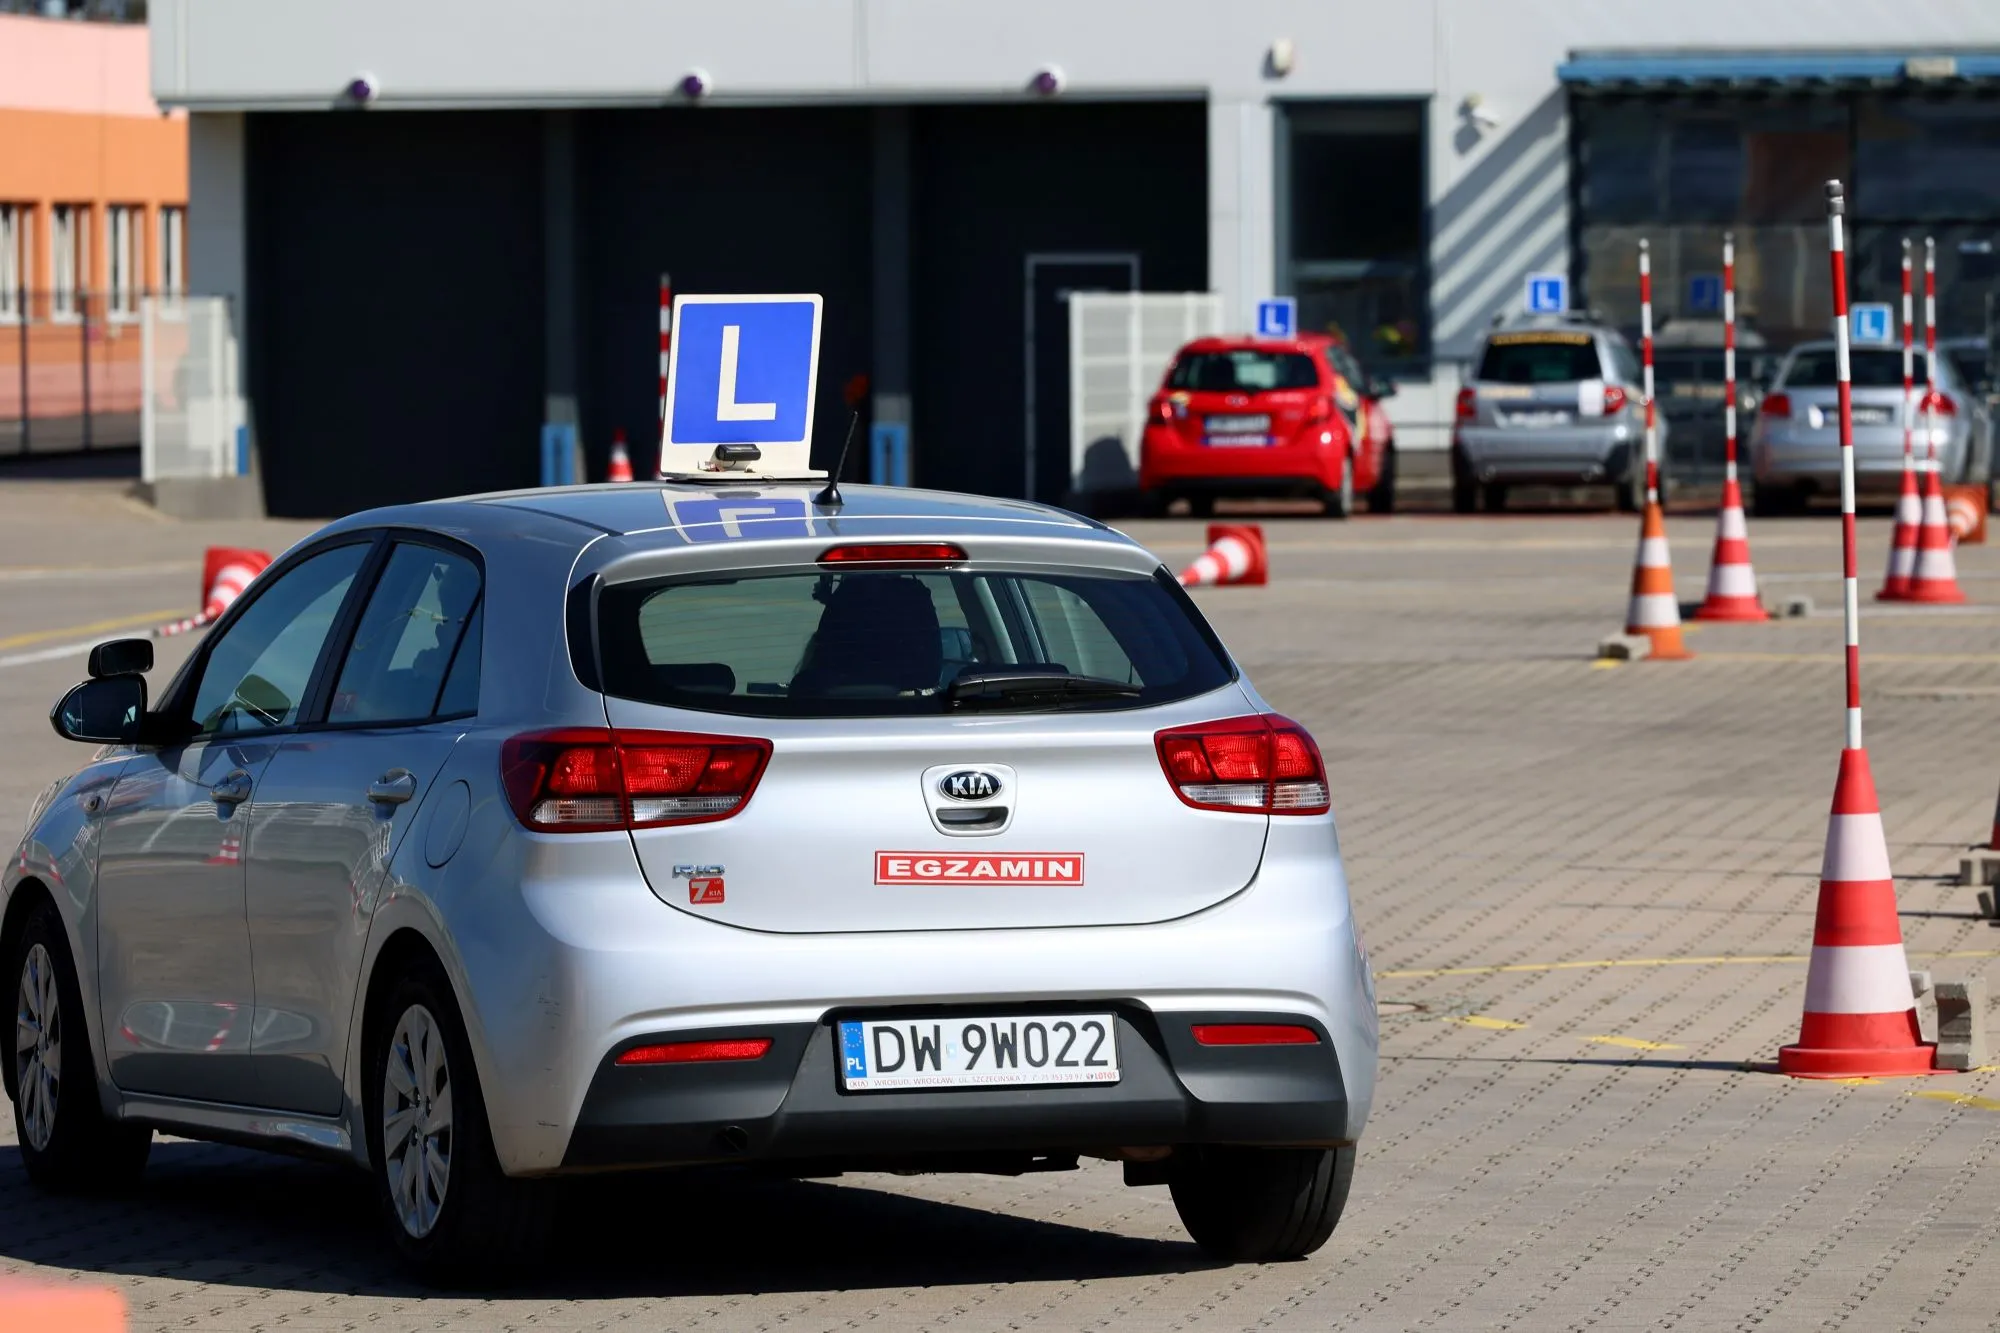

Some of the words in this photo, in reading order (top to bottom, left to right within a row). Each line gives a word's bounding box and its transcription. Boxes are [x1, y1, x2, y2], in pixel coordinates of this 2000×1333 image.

[1537, 280, 1558, 308] L
[1265, 303, 1285, 333] L
[1860, 309, 1879, 338] L
[717, 325, 776, 422] L
[951, 776, 993, 796] KIA
[672, 864, 725, 875] RIO
[888, 859, 1074, 879] EGZAMIN
[692, 881, 710, 902] 7
[872, 1024, 942, 1073] DW
[962, 1021, 1108, 1070] 9W022
[847, 1057, 863, 1071] PL
